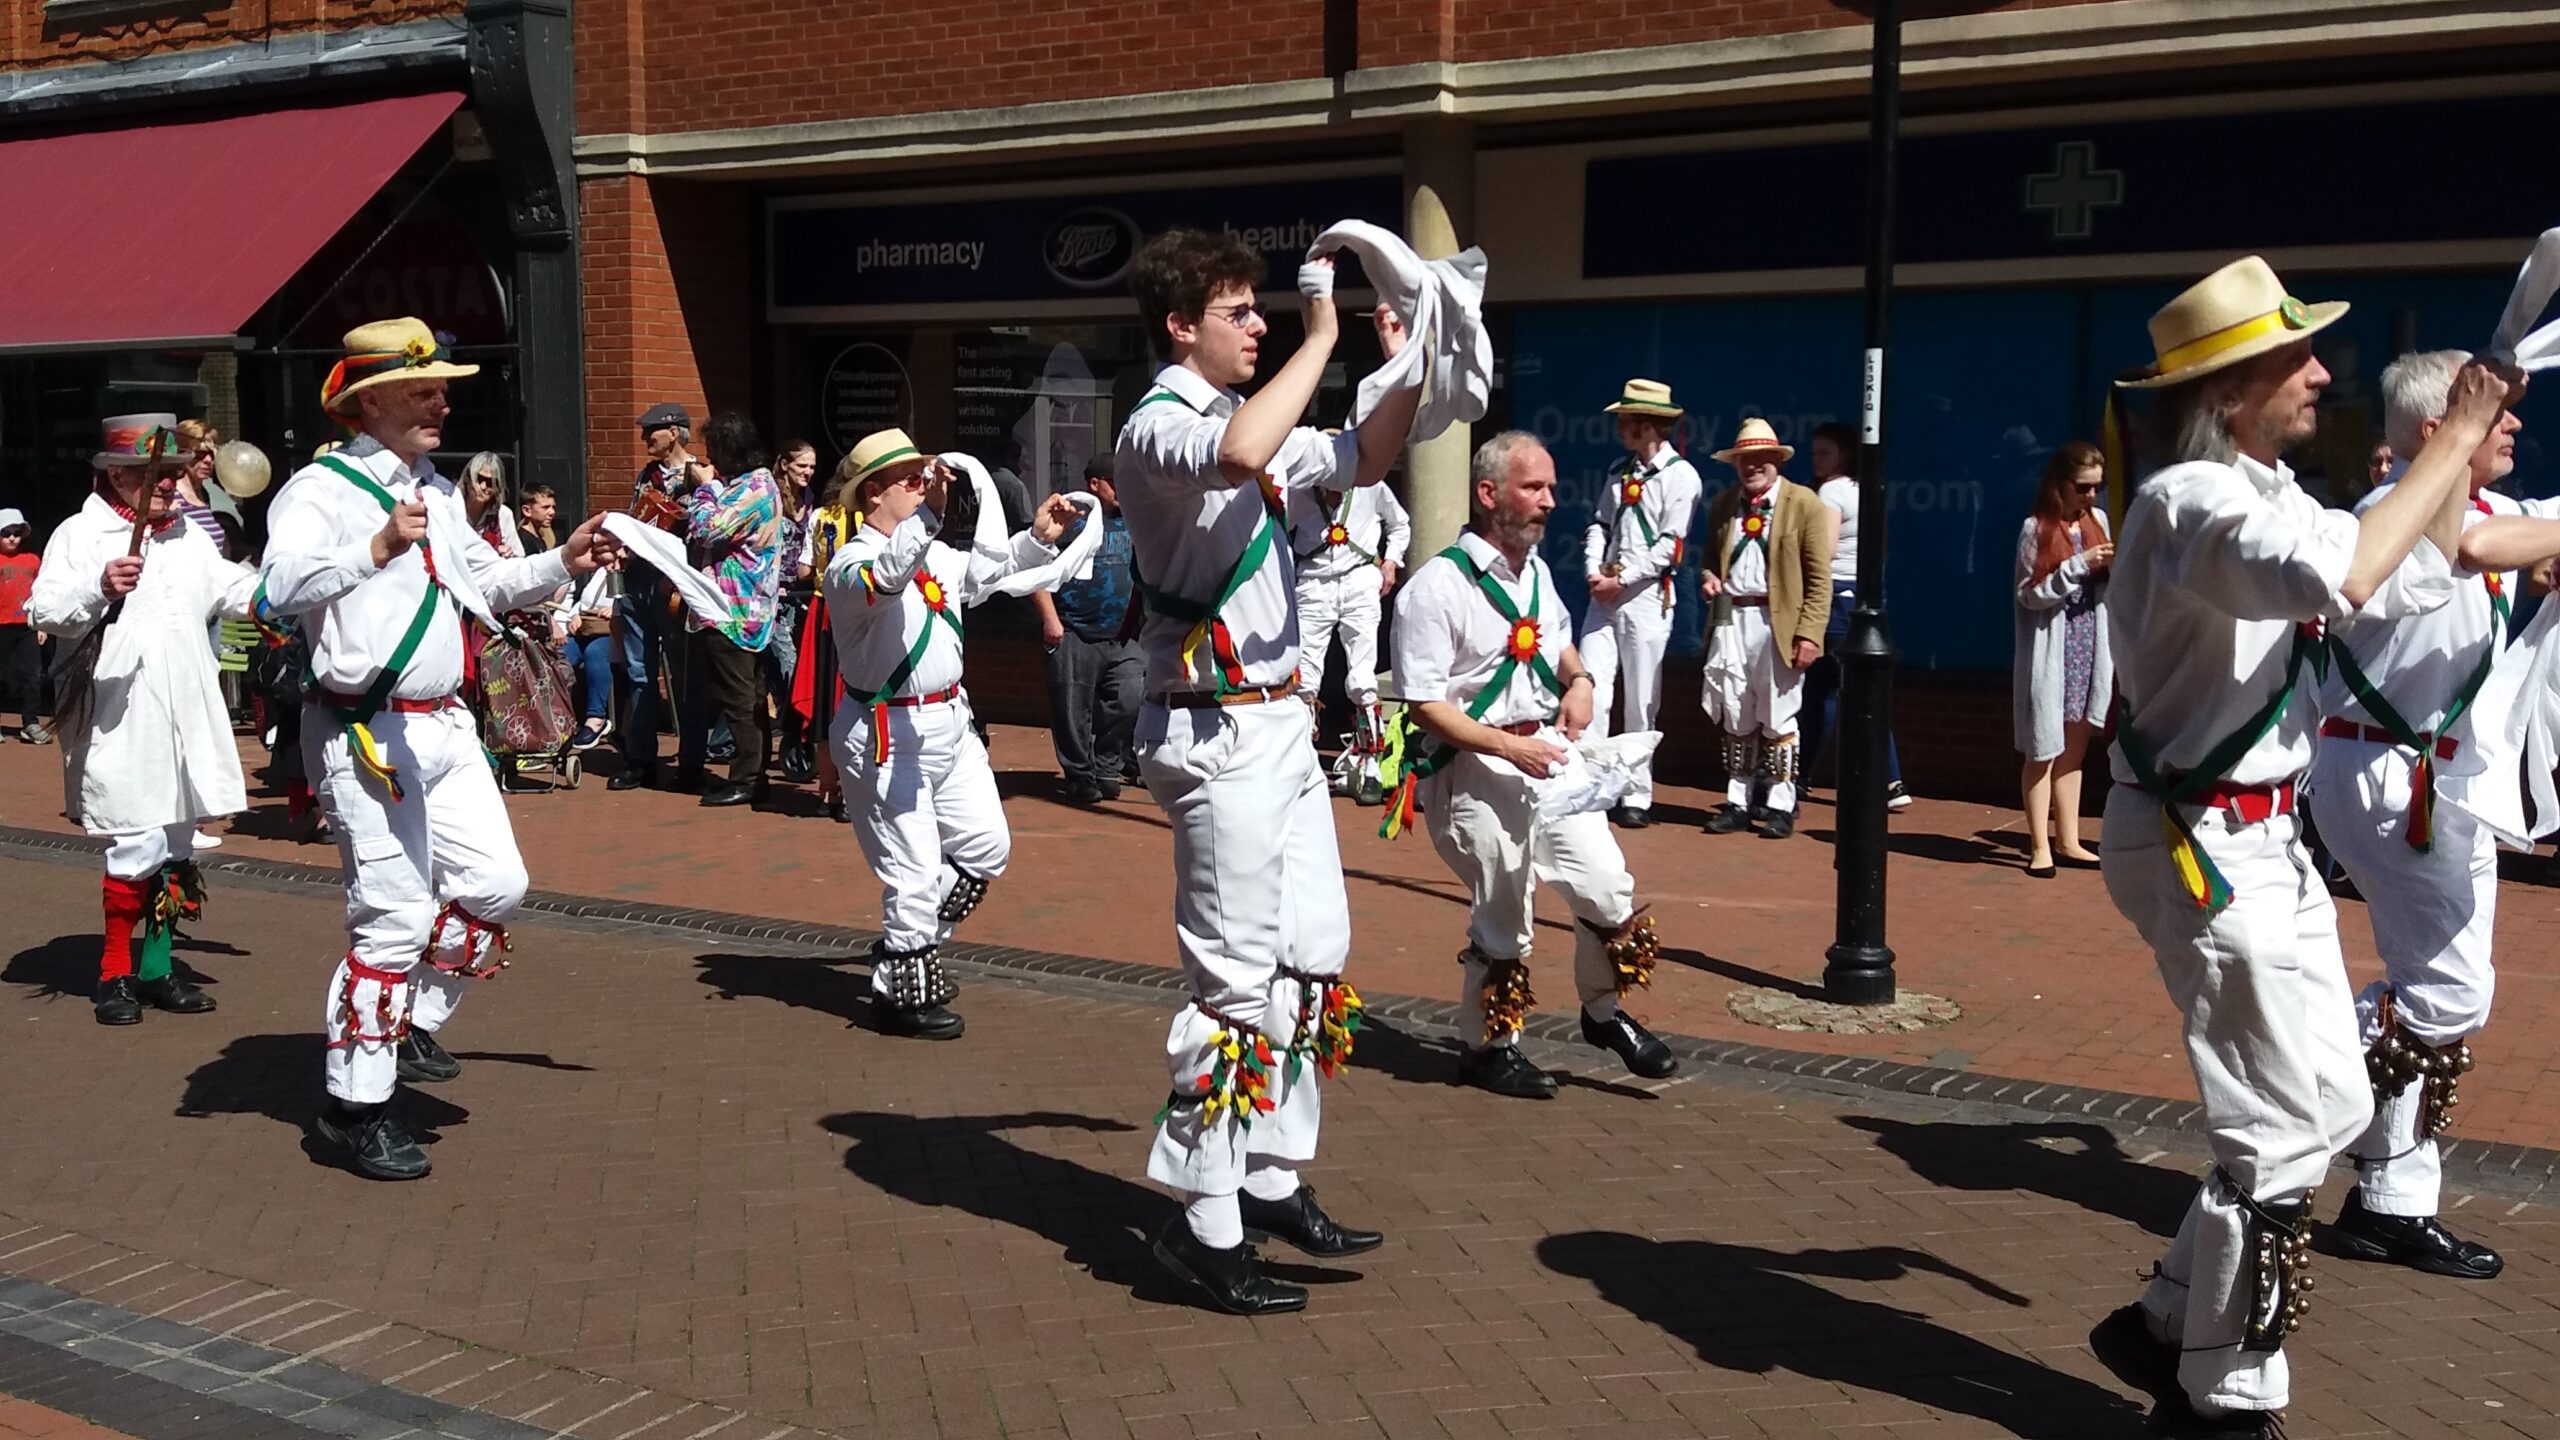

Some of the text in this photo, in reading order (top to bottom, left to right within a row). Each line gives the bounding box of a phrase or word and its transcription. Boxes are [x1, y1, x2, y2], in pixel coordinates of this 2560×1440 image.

[856, 237, 985, 274] pharmacy
[1052, 224, 1117, 268] Boots
[335, 264, 488, 318] COSTA
[958, 346, 977, 359] The
[957, 366, 1012, 381] fast acting
[958, 404, 996, 416] wrinkle
[958, 423, 1000, 436] solution
[1886, 479, 1985, 512] rom
